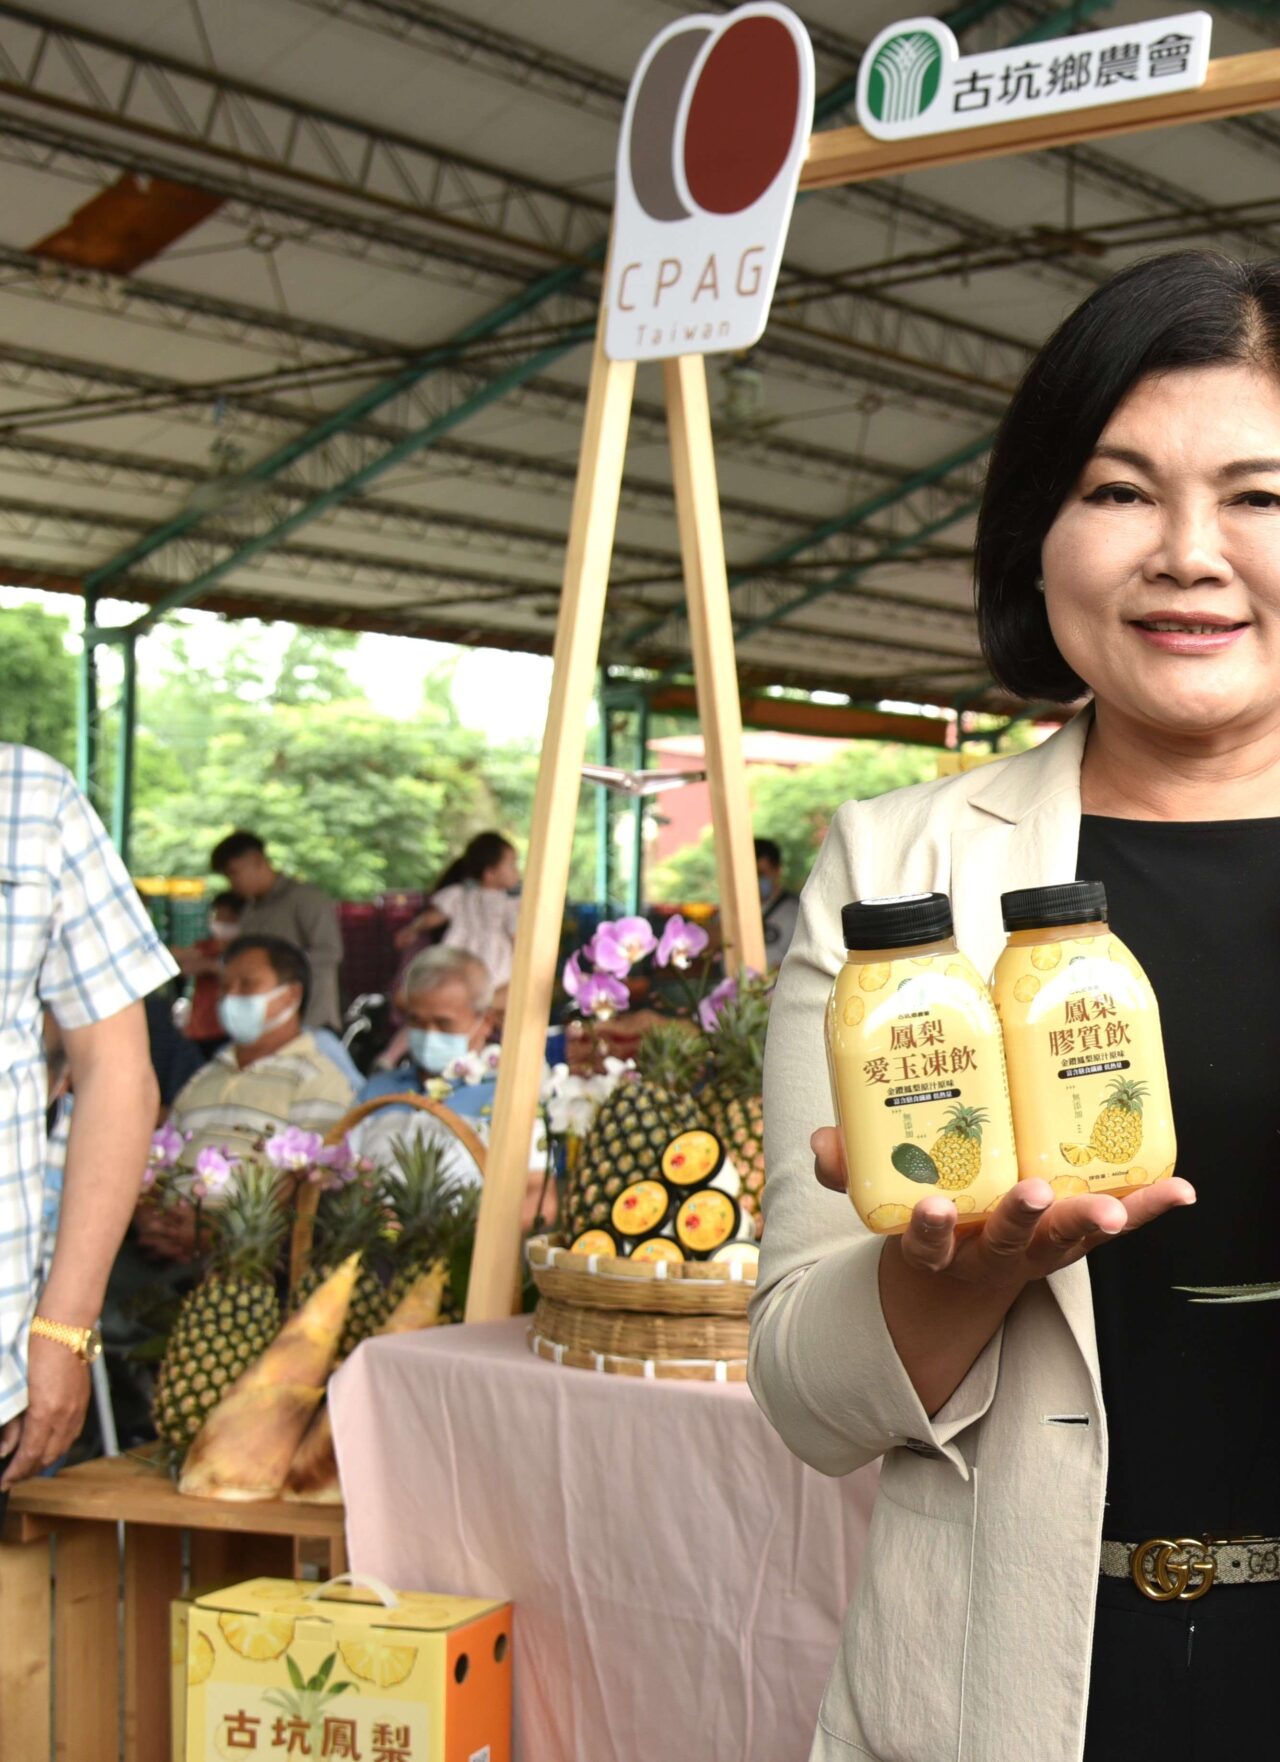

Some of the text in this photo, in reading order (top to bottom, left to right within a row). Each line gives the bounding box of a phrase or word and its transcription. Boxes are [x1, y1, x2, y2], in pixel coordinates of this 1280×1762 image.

[953, 32, 1194, 114] 古坑鄉農會
[618, 246, 766, 312] CPAG
[637, 320, 730, 347] Taiwan
[1065, 993, 1117, 1025] 鳳梨
[890, 1019, 945, 1051] 鳳梨
[1049, 1020, 1132, 1056] 膠質飲
[862, 1045, 978, 1087] 愛玉凍飲
[224, 1709, 413, 1762] 古坑鳳梨
